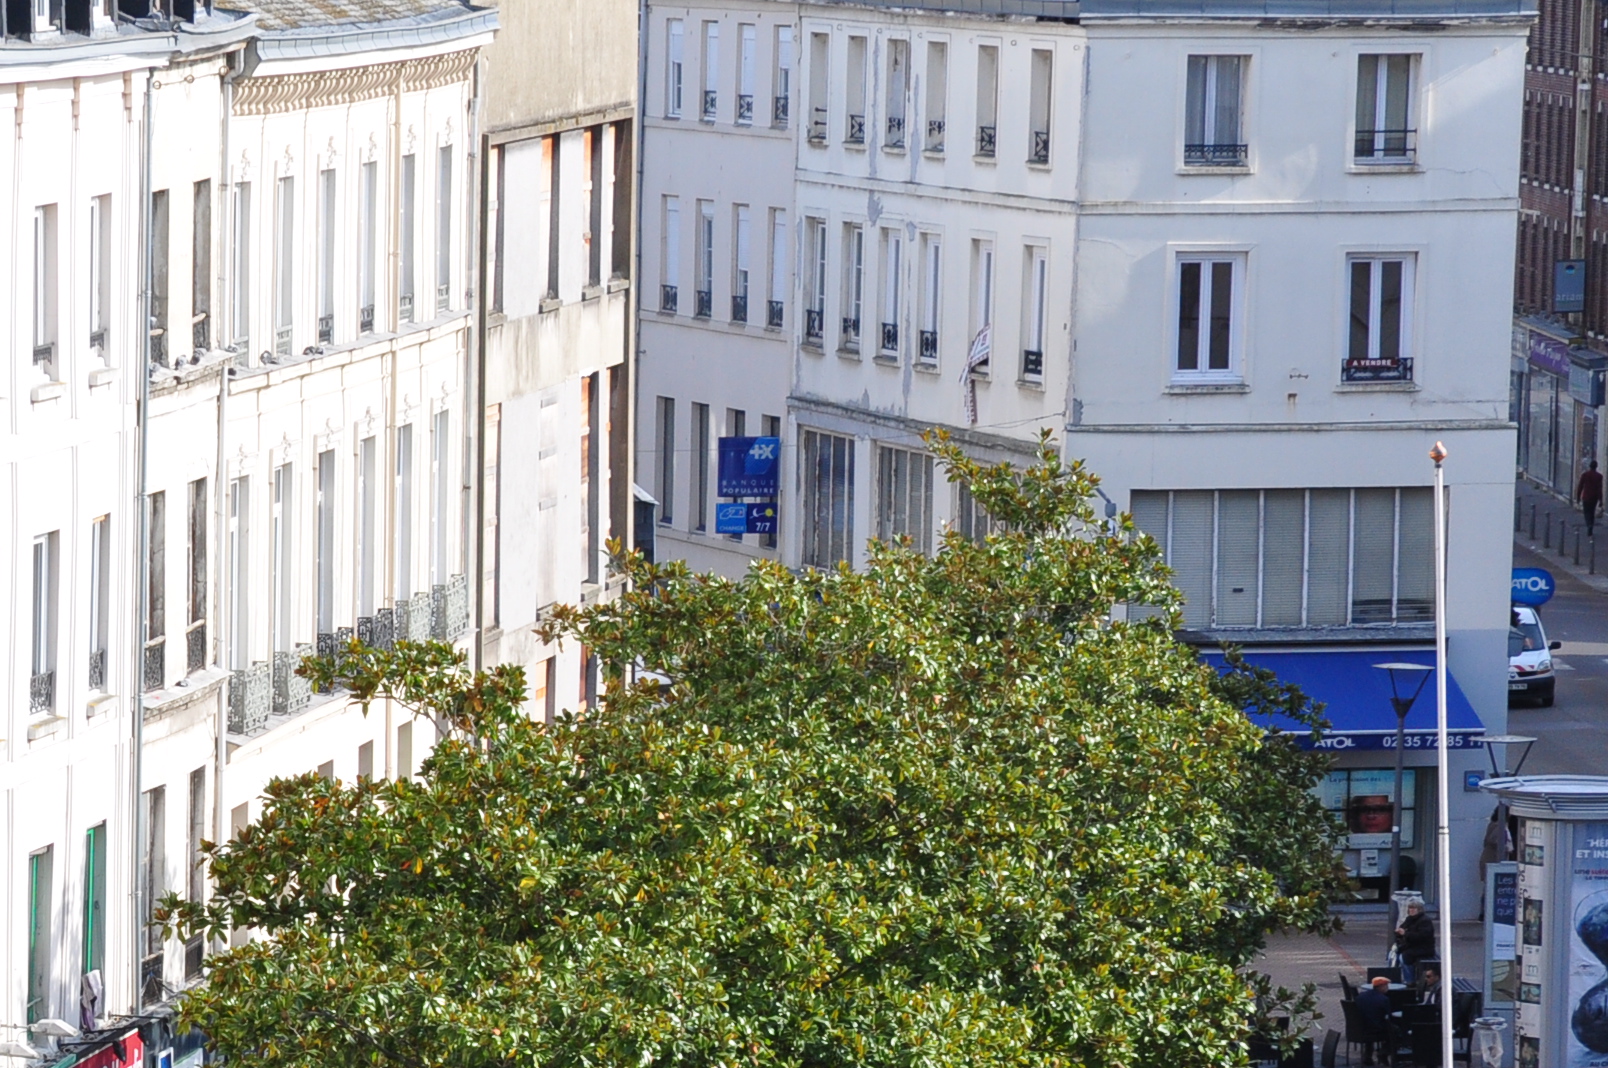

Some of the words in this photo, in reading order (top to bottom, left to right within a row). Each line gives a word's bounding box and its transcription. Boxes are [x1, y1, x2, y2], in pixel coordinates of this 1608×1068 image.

[755, 522, 771, 531] 7/7
[1511, 577, 1549, 591] ATOL
[1314, 736, 1356, 749] ATOL
[1404, 736, 1421, 747] 35
